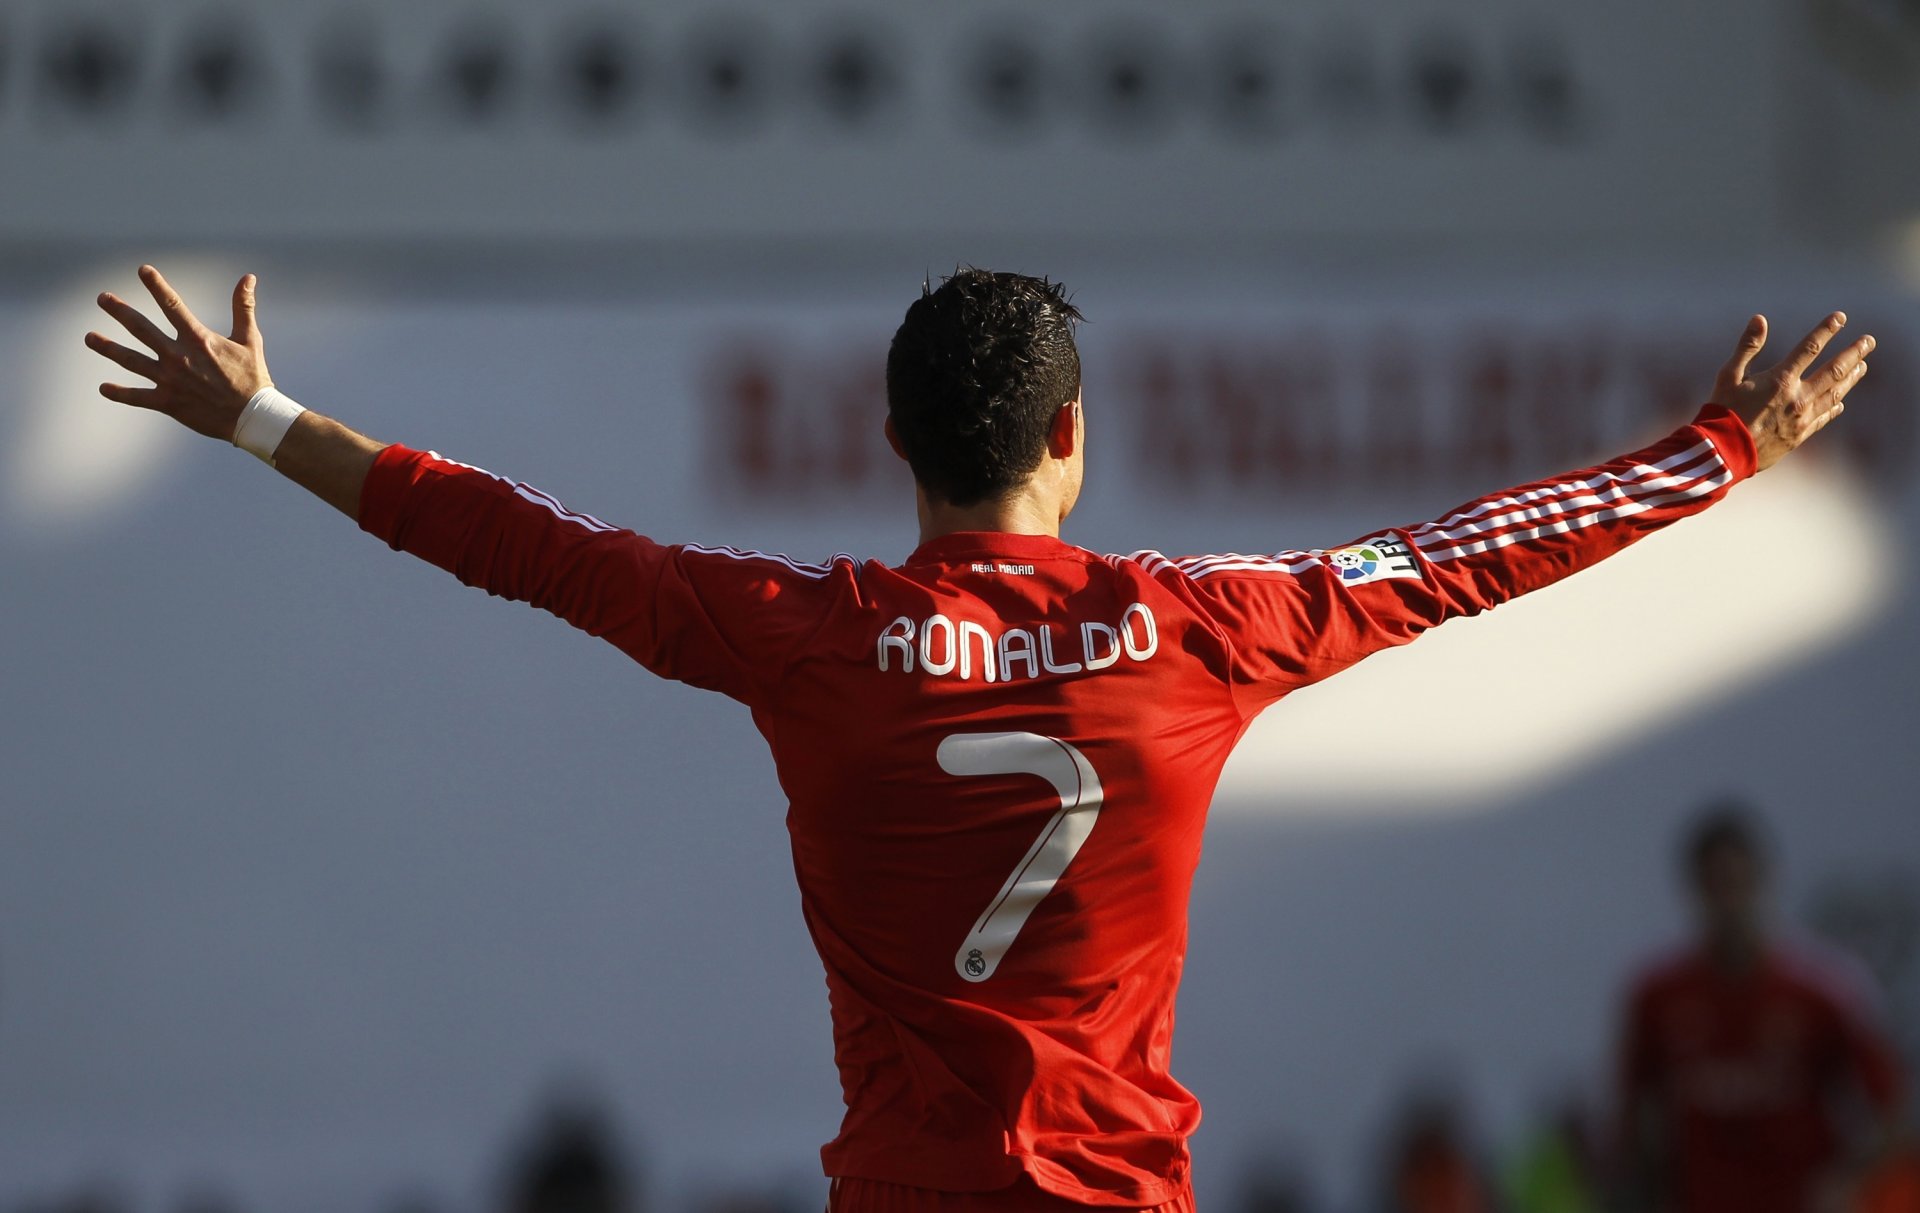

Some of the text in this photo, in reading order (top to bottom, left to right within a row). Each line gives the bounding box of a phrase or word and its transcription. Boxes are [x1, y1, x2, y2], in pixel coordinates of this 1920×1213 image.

[971, 563, 1035, 575] REAL MADRID
[877, 602, 1158, 683] RONALDO
[936, 731, 1104, 983] 7
